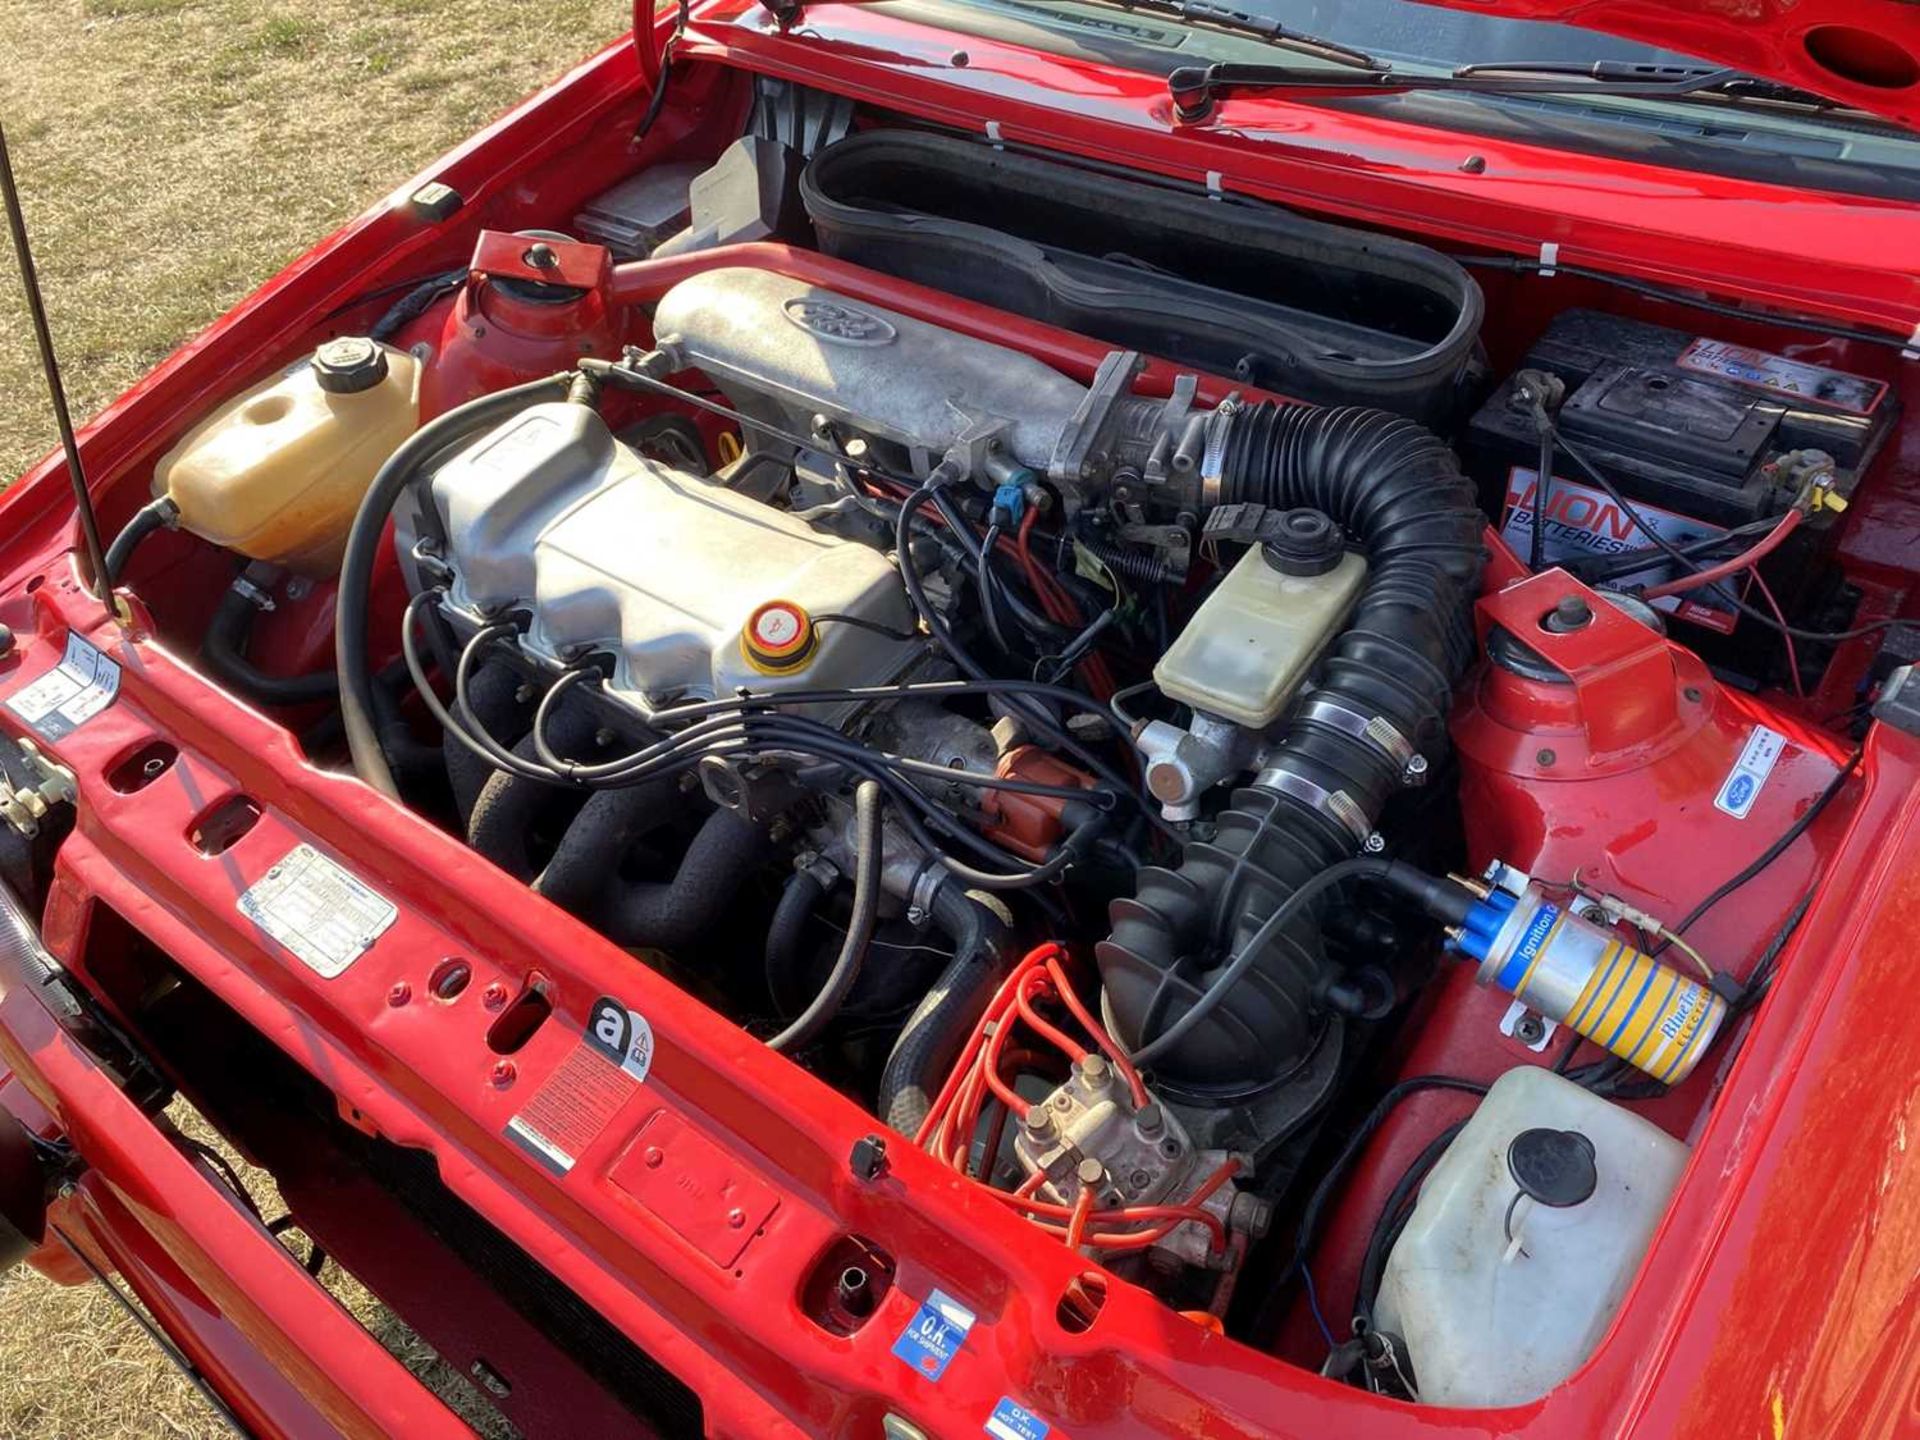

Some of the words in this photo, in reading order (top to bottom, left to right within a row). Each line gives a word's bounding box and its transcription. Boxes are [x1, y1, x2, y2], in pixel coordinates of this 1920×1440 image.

[1512, 510, 1624, 554] BATTERIES
[1519, 481, 1636, 541] LION
[1518, 913, 1553, 960] Ignition
[918, 1336, 950, 1361] SHIPMENT
[921, 1316, 950, 1348] O.K.
